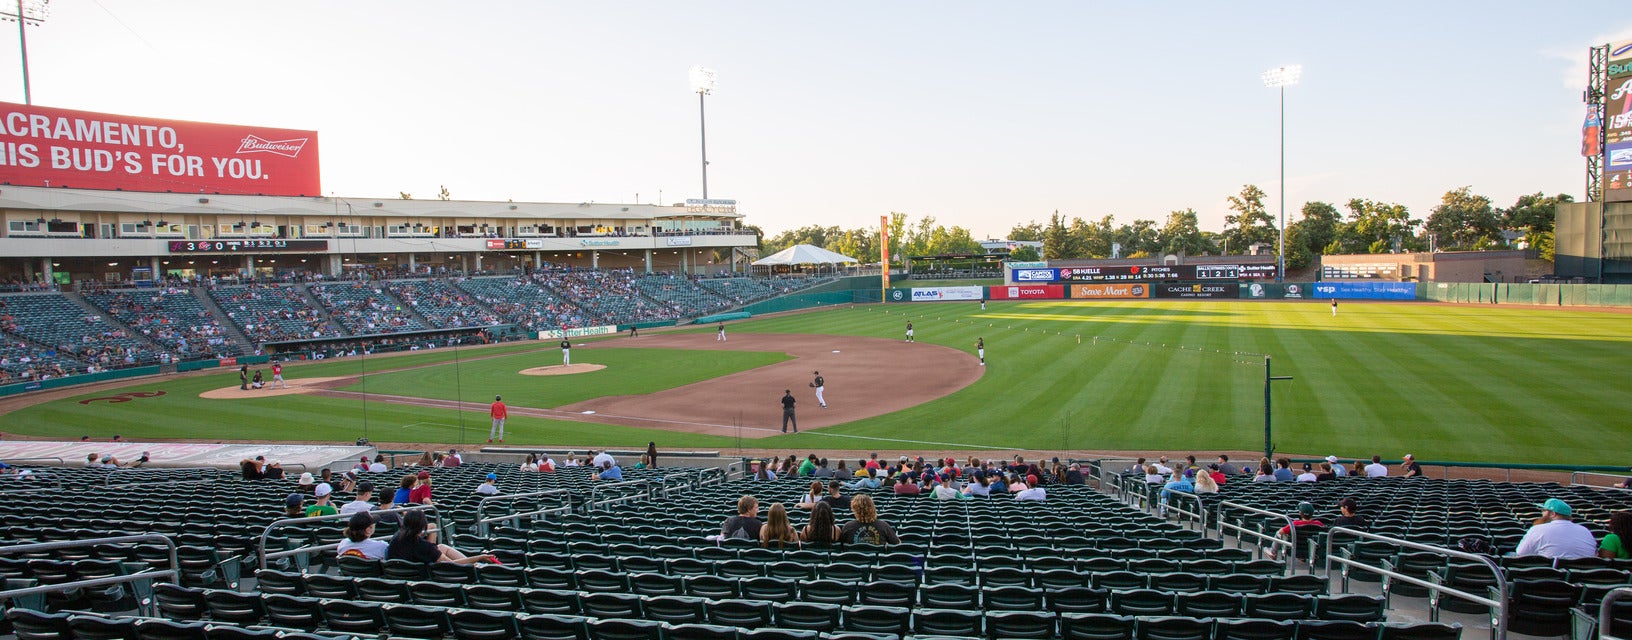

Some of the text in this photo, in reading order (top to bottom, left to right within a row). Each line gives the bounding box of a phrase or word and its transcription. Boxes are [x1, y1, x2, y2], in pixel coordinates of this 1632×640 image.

[241, 139, 301, 151] Budweiser
[51, 146, 142, 174] BUD'S
[152, 153, 204, 176] FOR
[212, 157, 269, 179] YOU.
[187, 242, 223, 250] 3 0
[1082, 287, 1101, 296] Save
[1103, 287, 1128, 296] Mart
[556, 327, 608, 338] Stter Health
